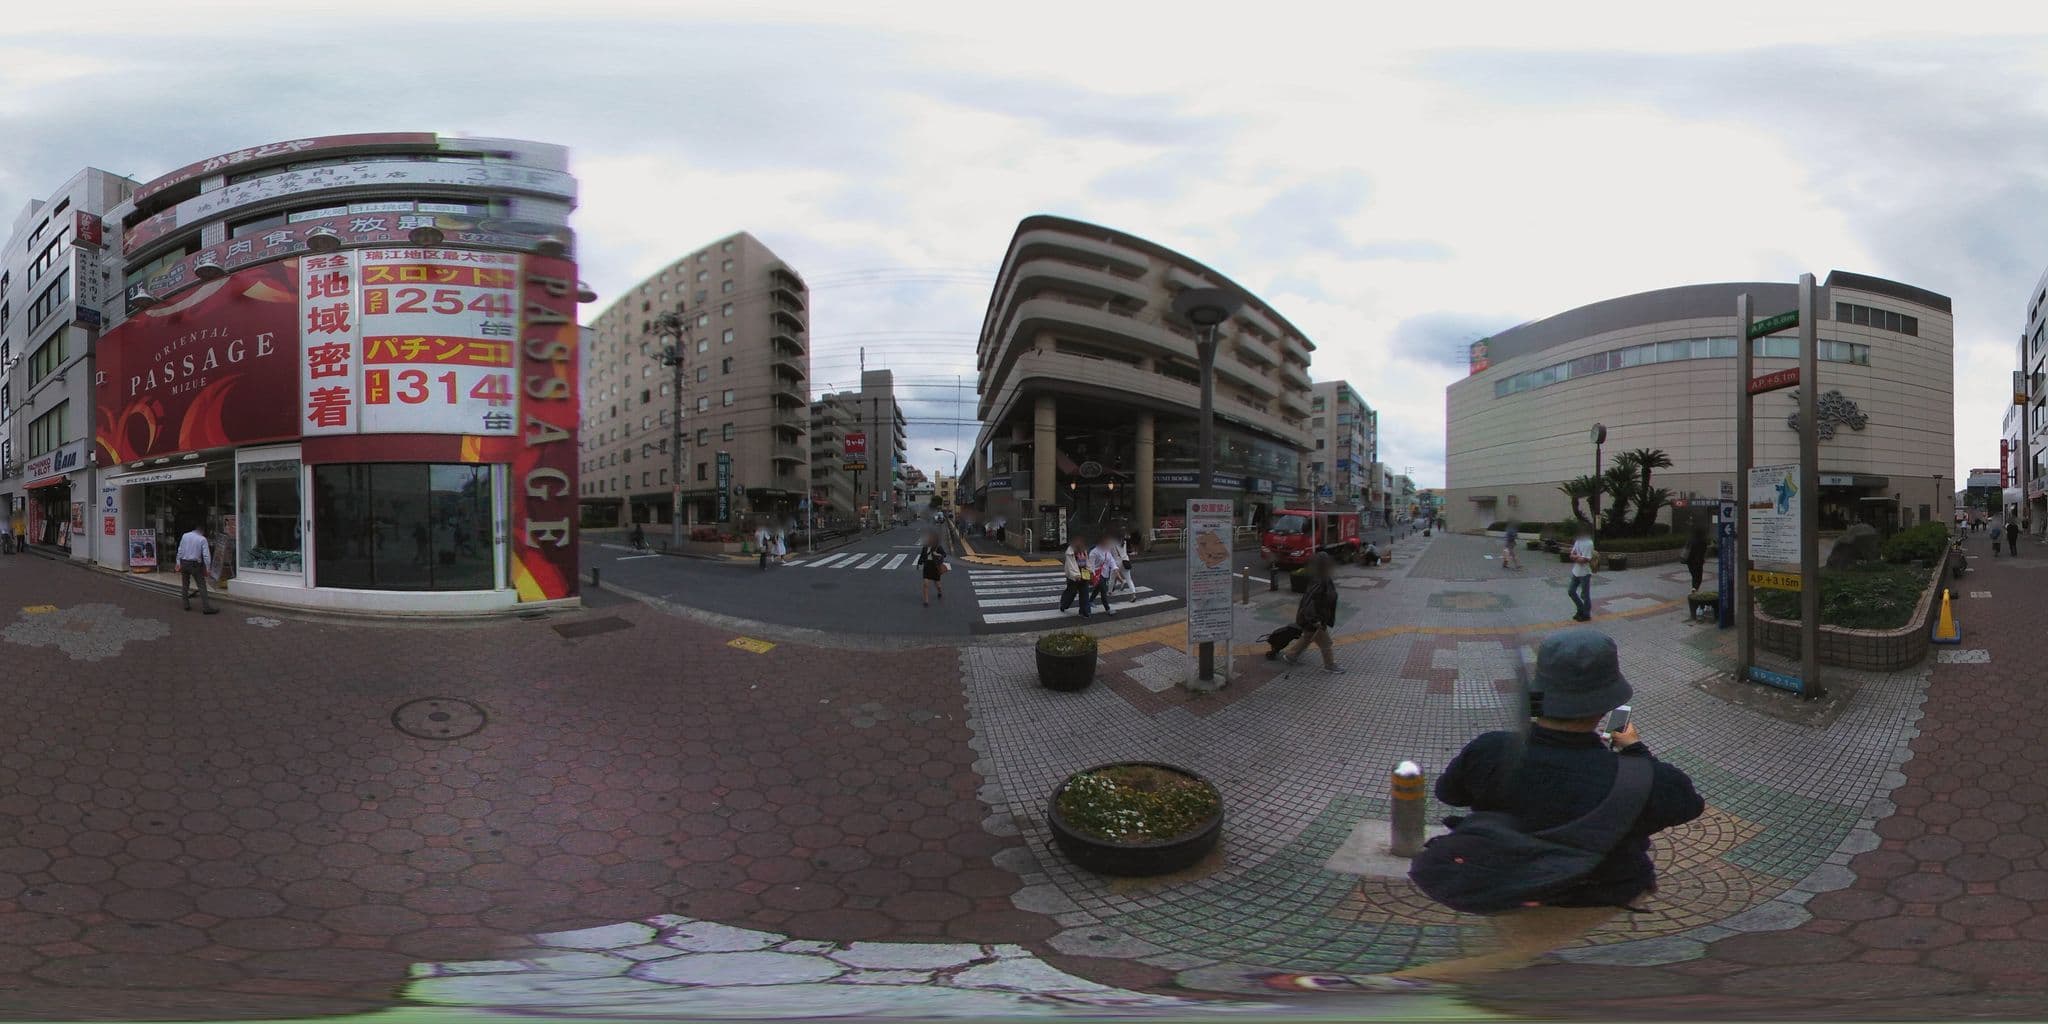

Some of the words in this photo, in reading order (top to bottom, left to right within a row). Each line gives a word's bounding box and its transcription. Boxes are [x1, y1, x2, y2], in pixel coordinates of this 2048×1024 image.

[306, 255, 349, 270] 完全
[365, 265, 513, 286] スロット
[370, 291, 383, 313] 2F
[395, 287, 513, 318] 254
[154, 327, 230, 362] ORIENTAL
[306, 270, 352, 428] 地域密着
[366, 336, 511, 362] パチンコ
[130, 332, 275, 396] PASSAGE
[171, 376, 208, 396] MIZUE
[370, 373, 384, 402] 1F
[396, 370, 513, 407] 314
[525, 273, 571, 549] PASSAGE
